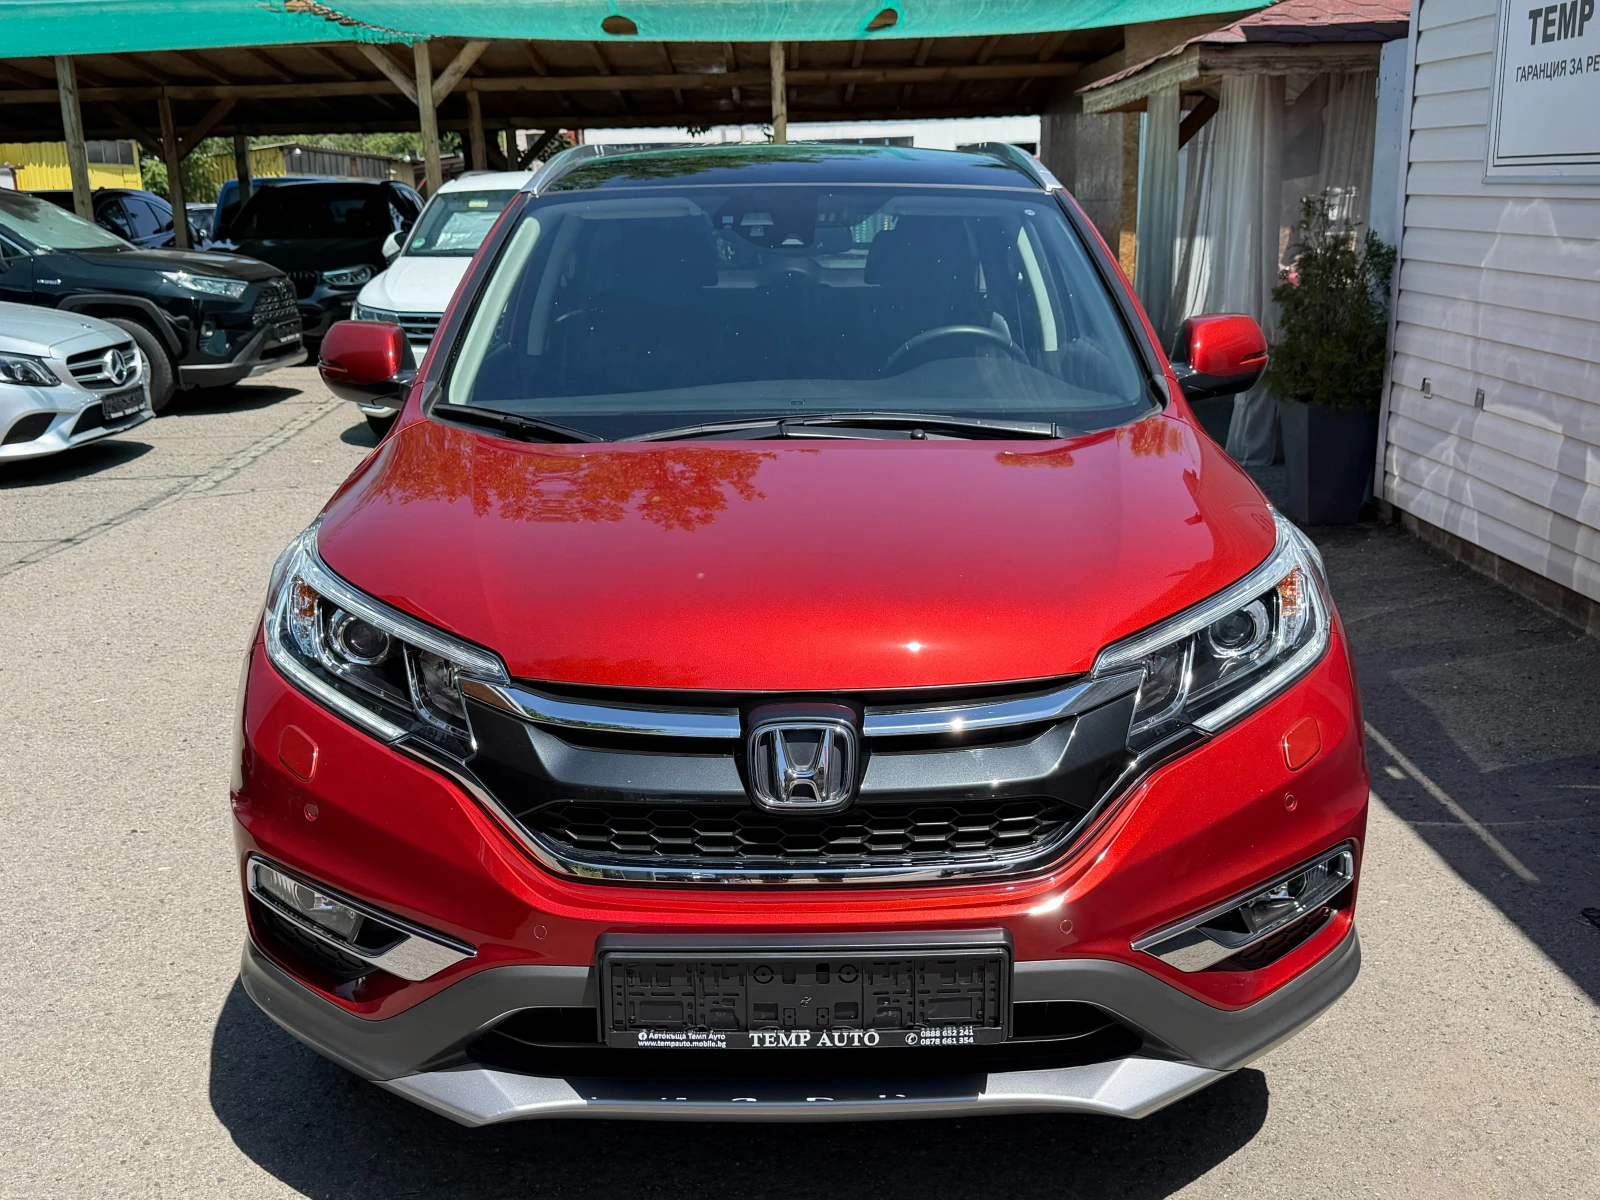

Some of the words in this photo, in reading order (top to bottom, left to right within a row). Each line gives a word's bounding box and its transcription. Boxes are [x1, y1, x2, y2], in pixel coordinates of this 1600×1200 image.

[1528, 0, 1595, 46] TEMP
[1515, 59, 1567, 83] ГАРАНЦИЯ
[1569, 57, 1583, 76] ЗА
[1586, 54, 1600, 73] РЕ
[637, 1040, 727, 1048] www.tempauto.mobile.bg
[748, 1031, 811, 1047] TEMP
[816, 1031, 880, 1047] AUTO
